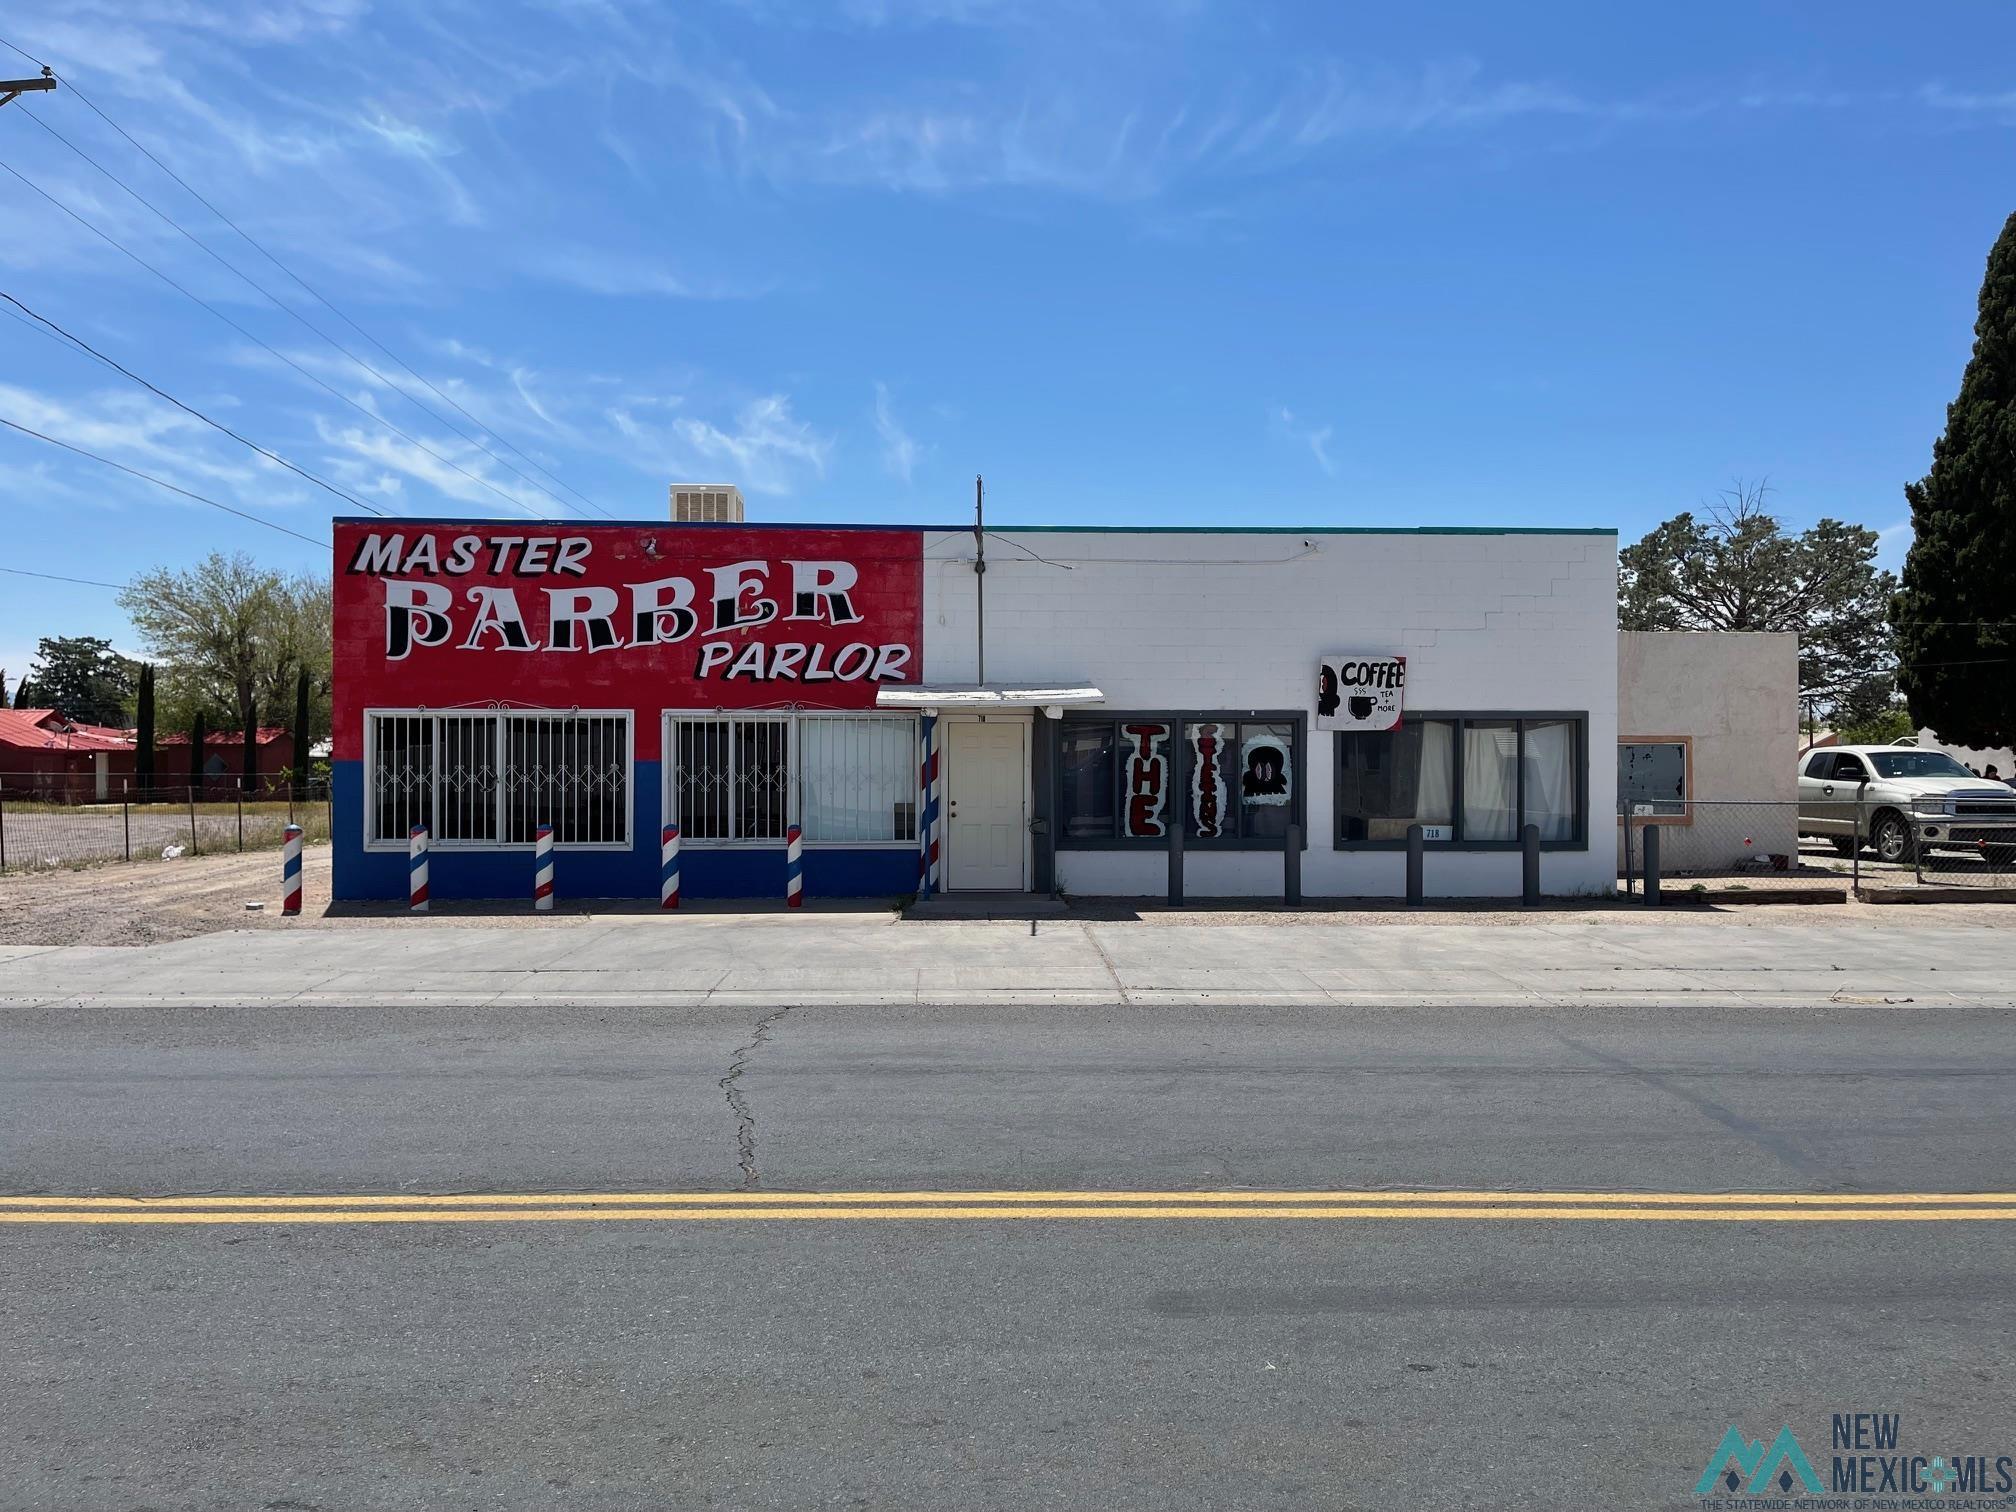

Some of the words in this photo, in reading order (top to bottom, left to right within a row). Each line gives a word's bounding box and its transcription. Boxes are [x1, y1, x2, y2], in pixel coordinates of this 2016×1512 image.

[350, 533, 593, 576] MASTER
[383, 559, 865, 660] BARBER
[697, 641, 912, 683] PARLOR
[1341, 661, 1405, 688] COFFEE
[1380, 690, 1394, 698] TEA
[1125, 724, 1166, 836] THE
[1426, 829, 1440, 838] 718
